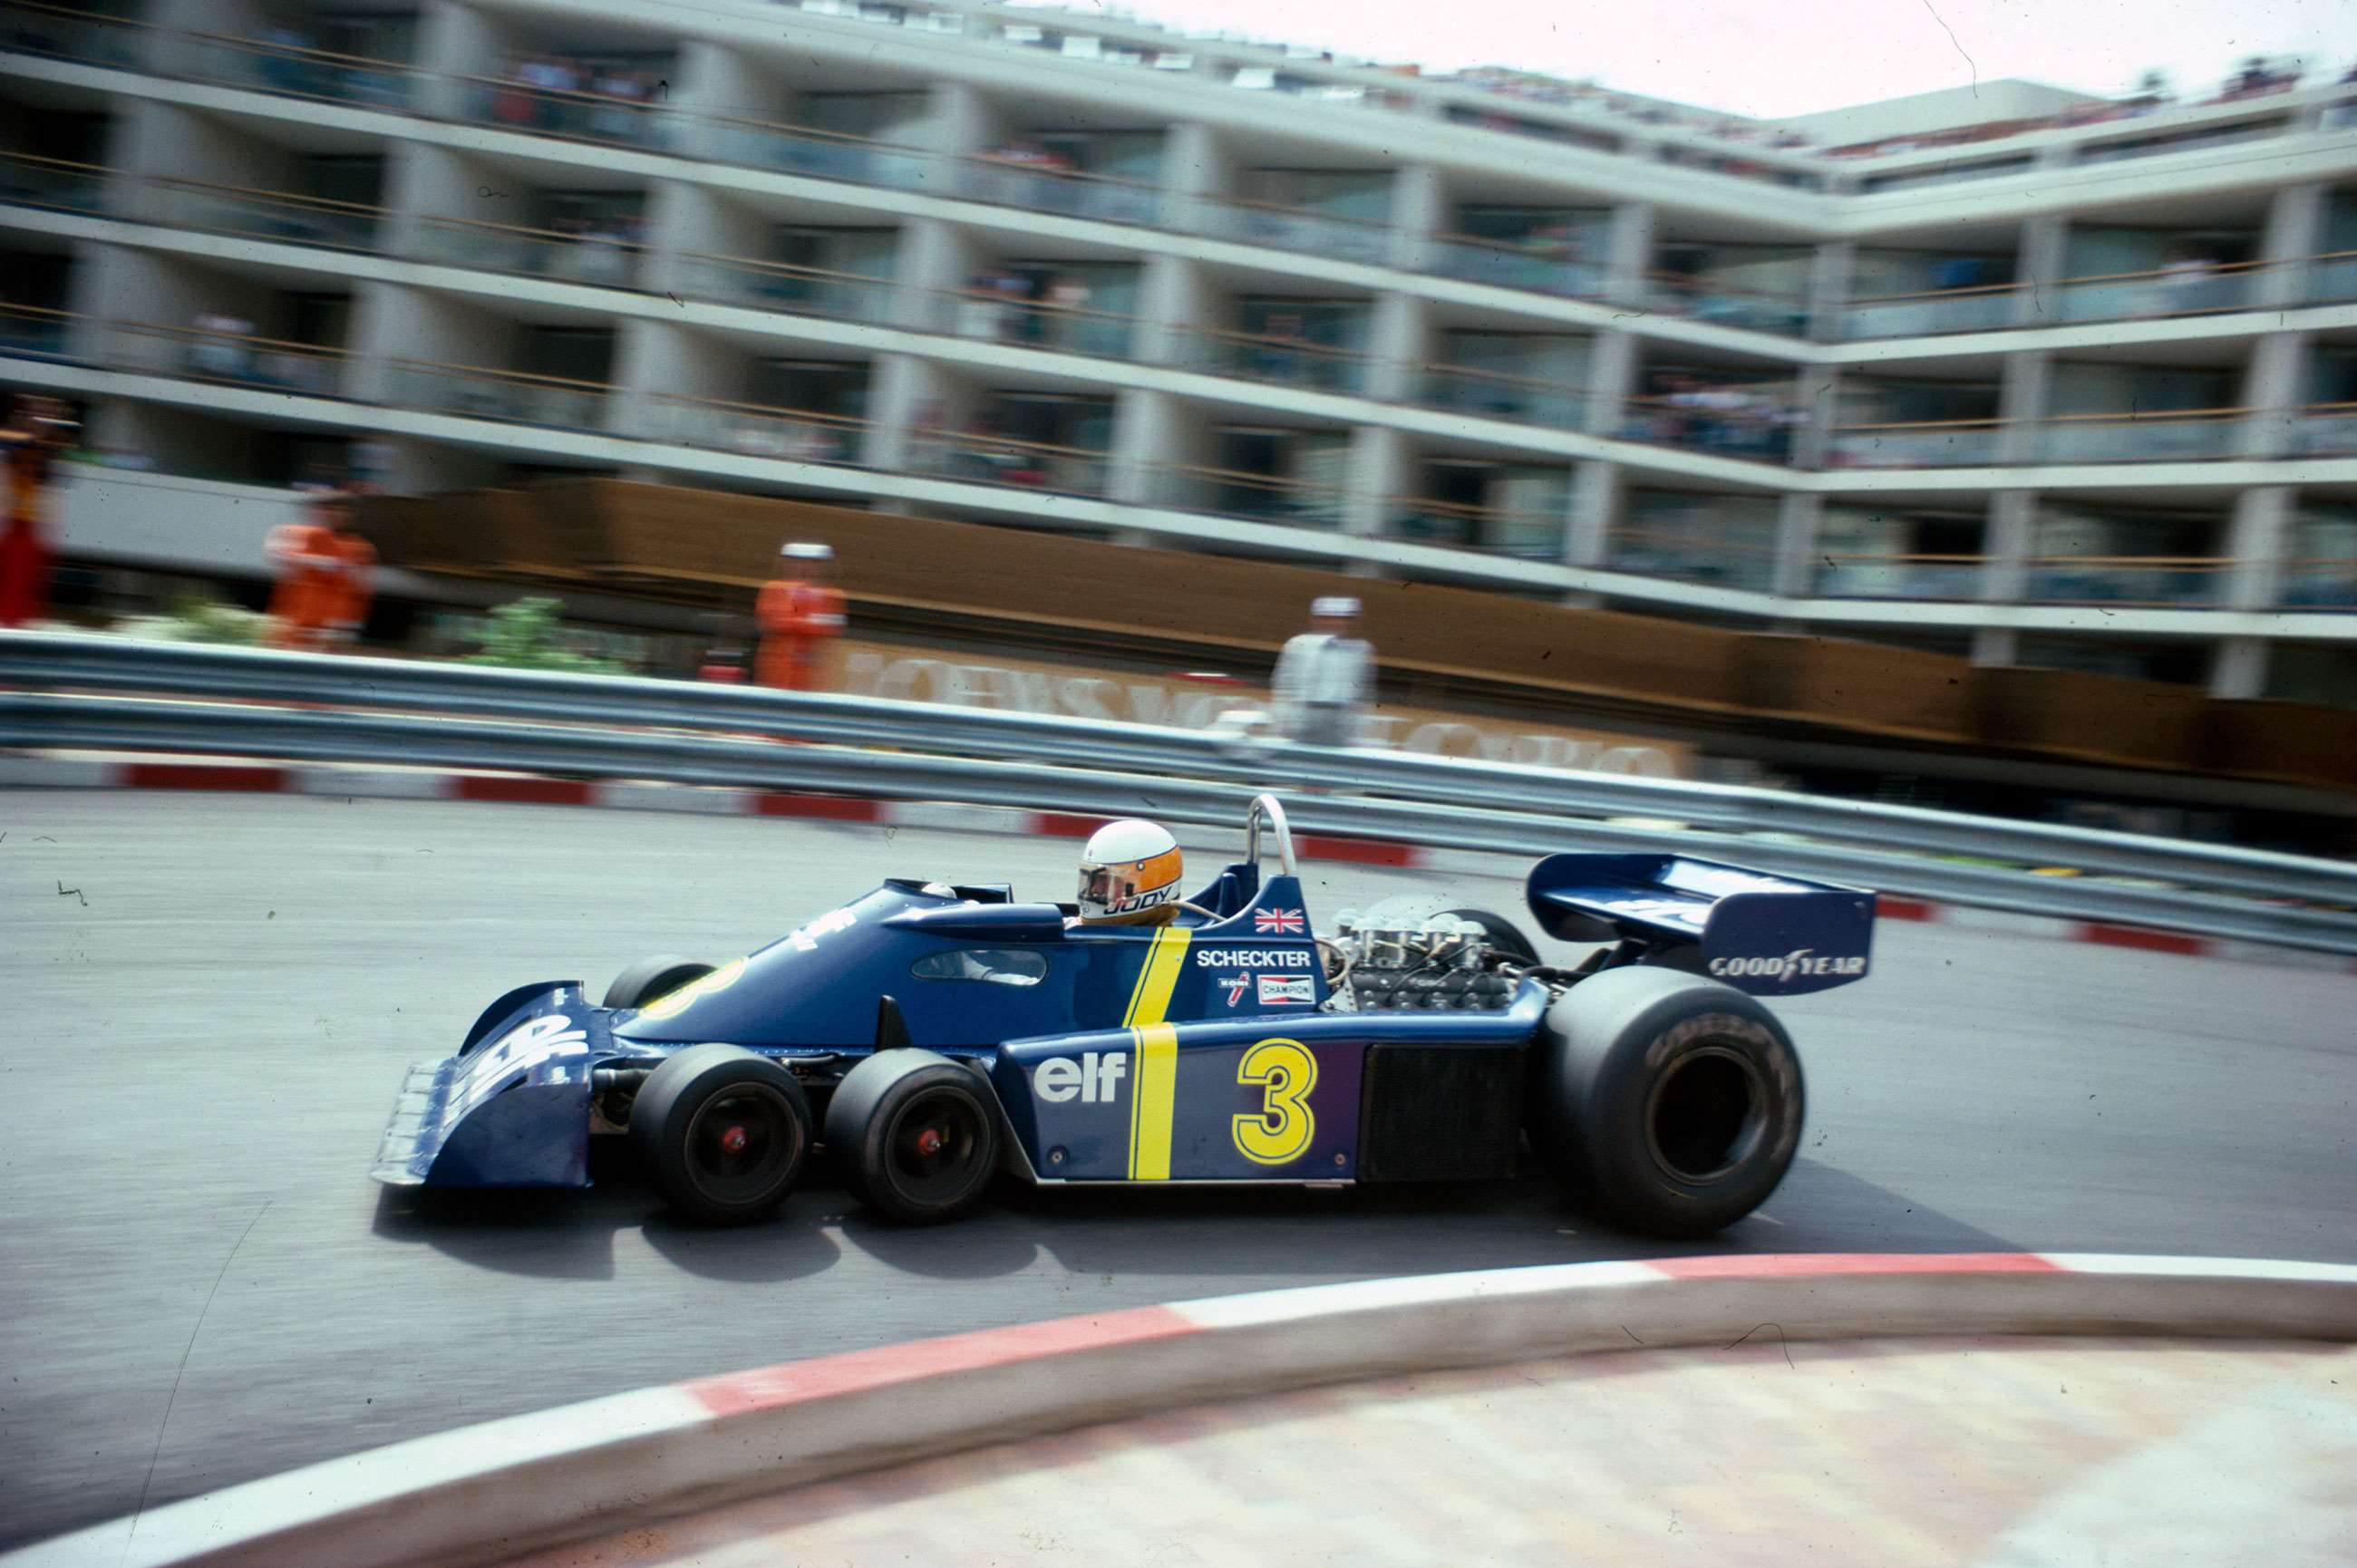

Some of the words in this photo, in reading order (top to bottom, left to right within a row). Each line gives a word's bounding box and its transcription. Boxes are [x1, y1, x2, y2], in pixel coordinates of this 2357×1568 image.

[1104, 886, 1172, 915] JODY
[1197, 950, 1311, 967] SCHECKTER
[1263, 984, 1309, 994] CHAMPION
[1033, 1052, 1126, 1103] elf
[1231, 1038, 1319, 1165] 3
